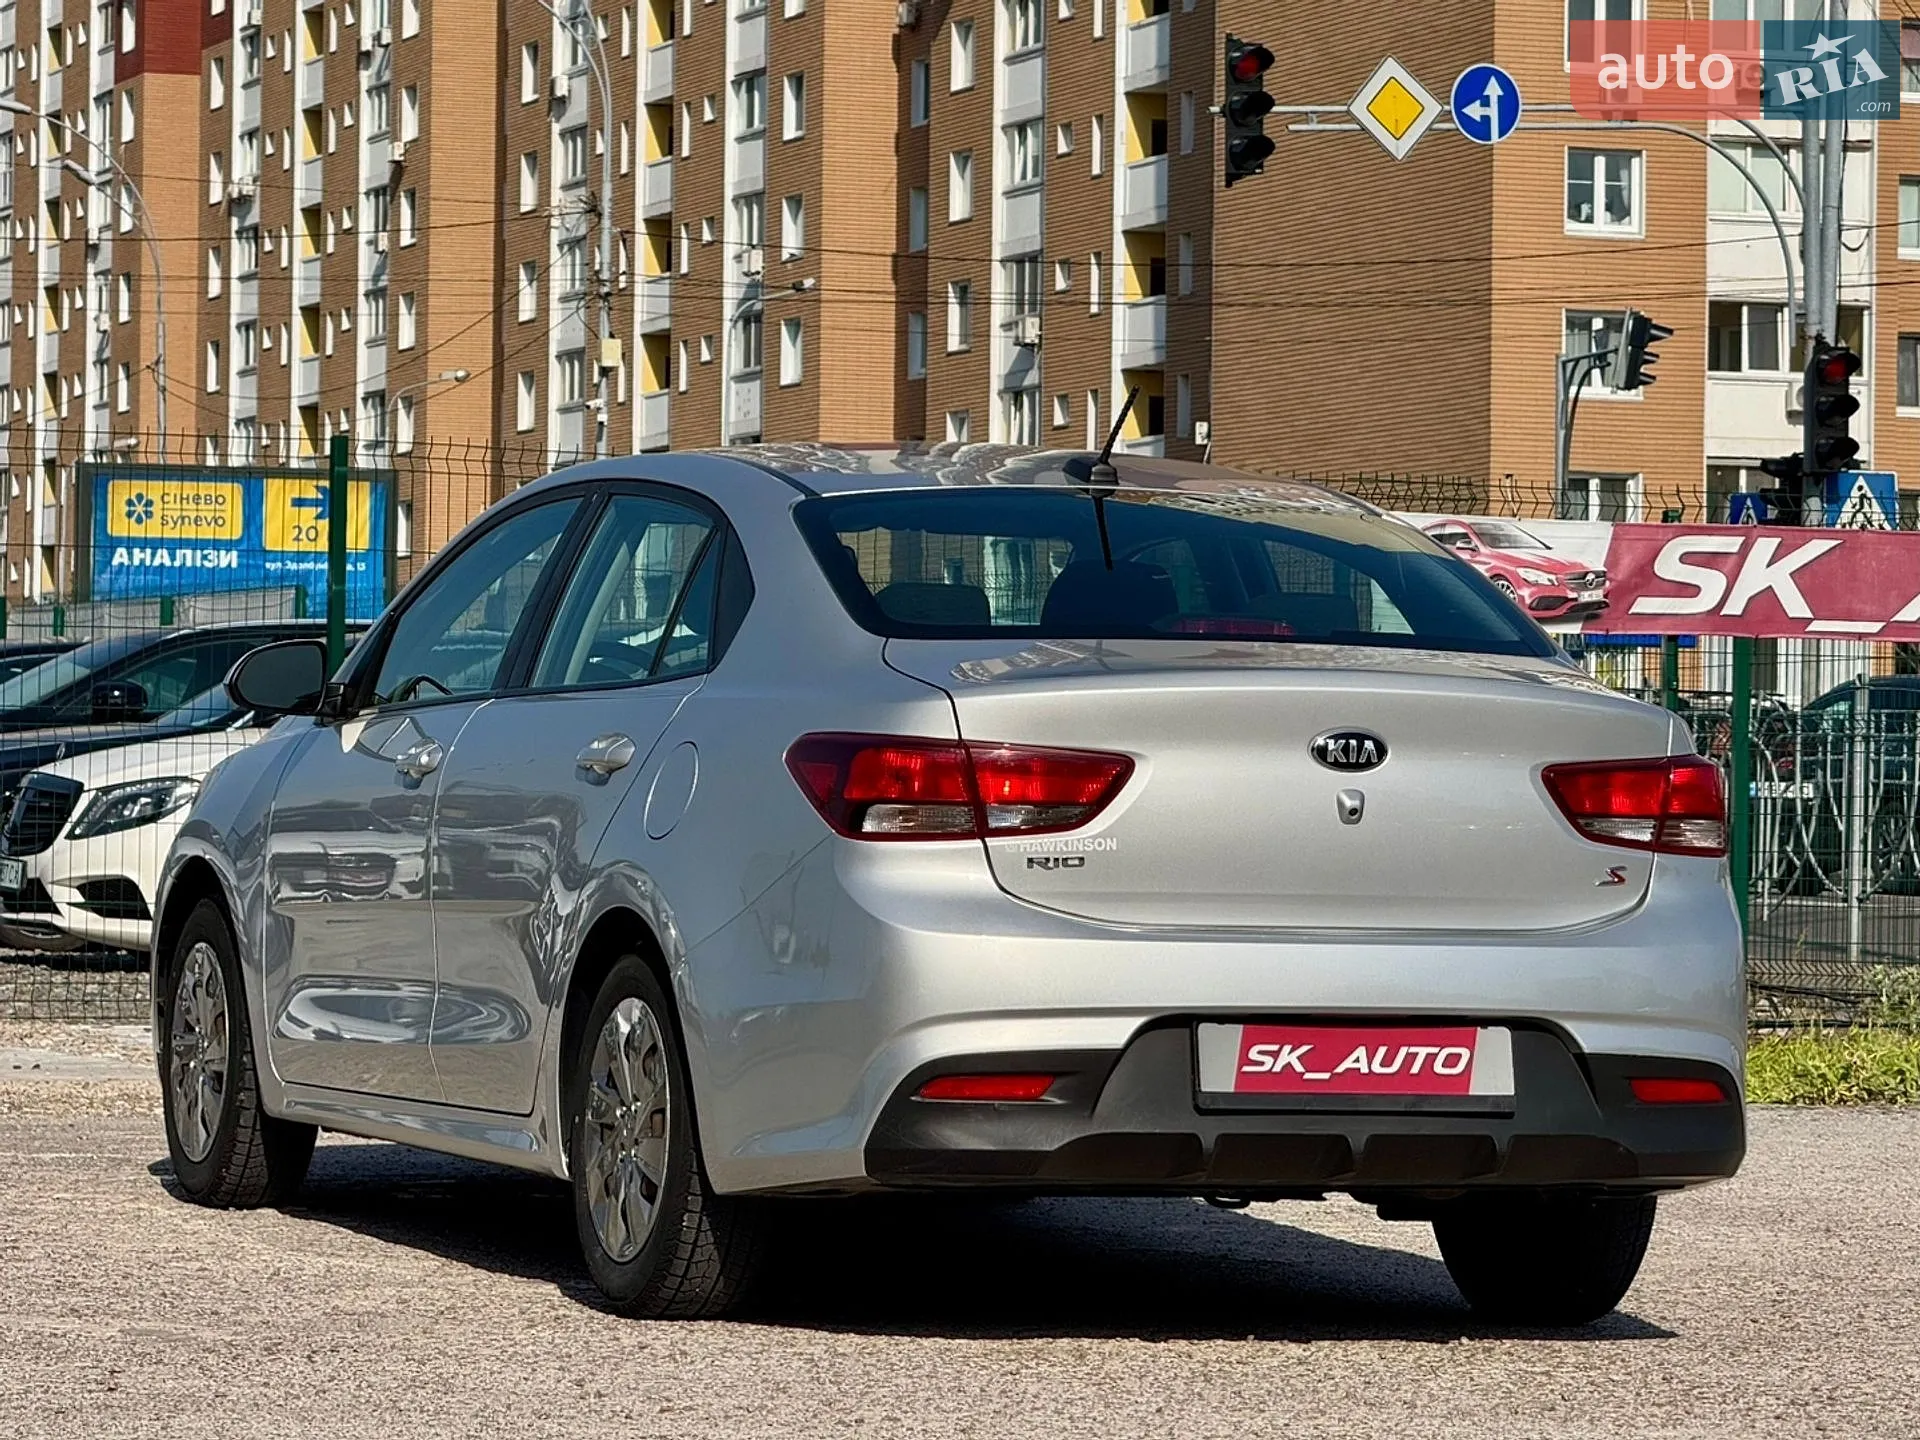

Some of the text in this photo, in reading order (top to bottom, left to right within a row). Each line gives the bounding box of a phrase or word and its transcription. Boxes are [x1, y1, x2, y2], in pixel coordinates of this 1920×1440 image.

[160, 513, 227, 530] synevo
[291, 525, 319, 542] 20
[111, 546, 239, 569] АНАЛІЗИ
[1325, 738, 1379, 763] KIA
[1019, 837, 1117, 853] HAWKINSON
[1026, 856, 1086, 871] RIO
[1592, 865, 1628, 887] S
[1240, 1044, 1471, 1080] SK_AUTO
